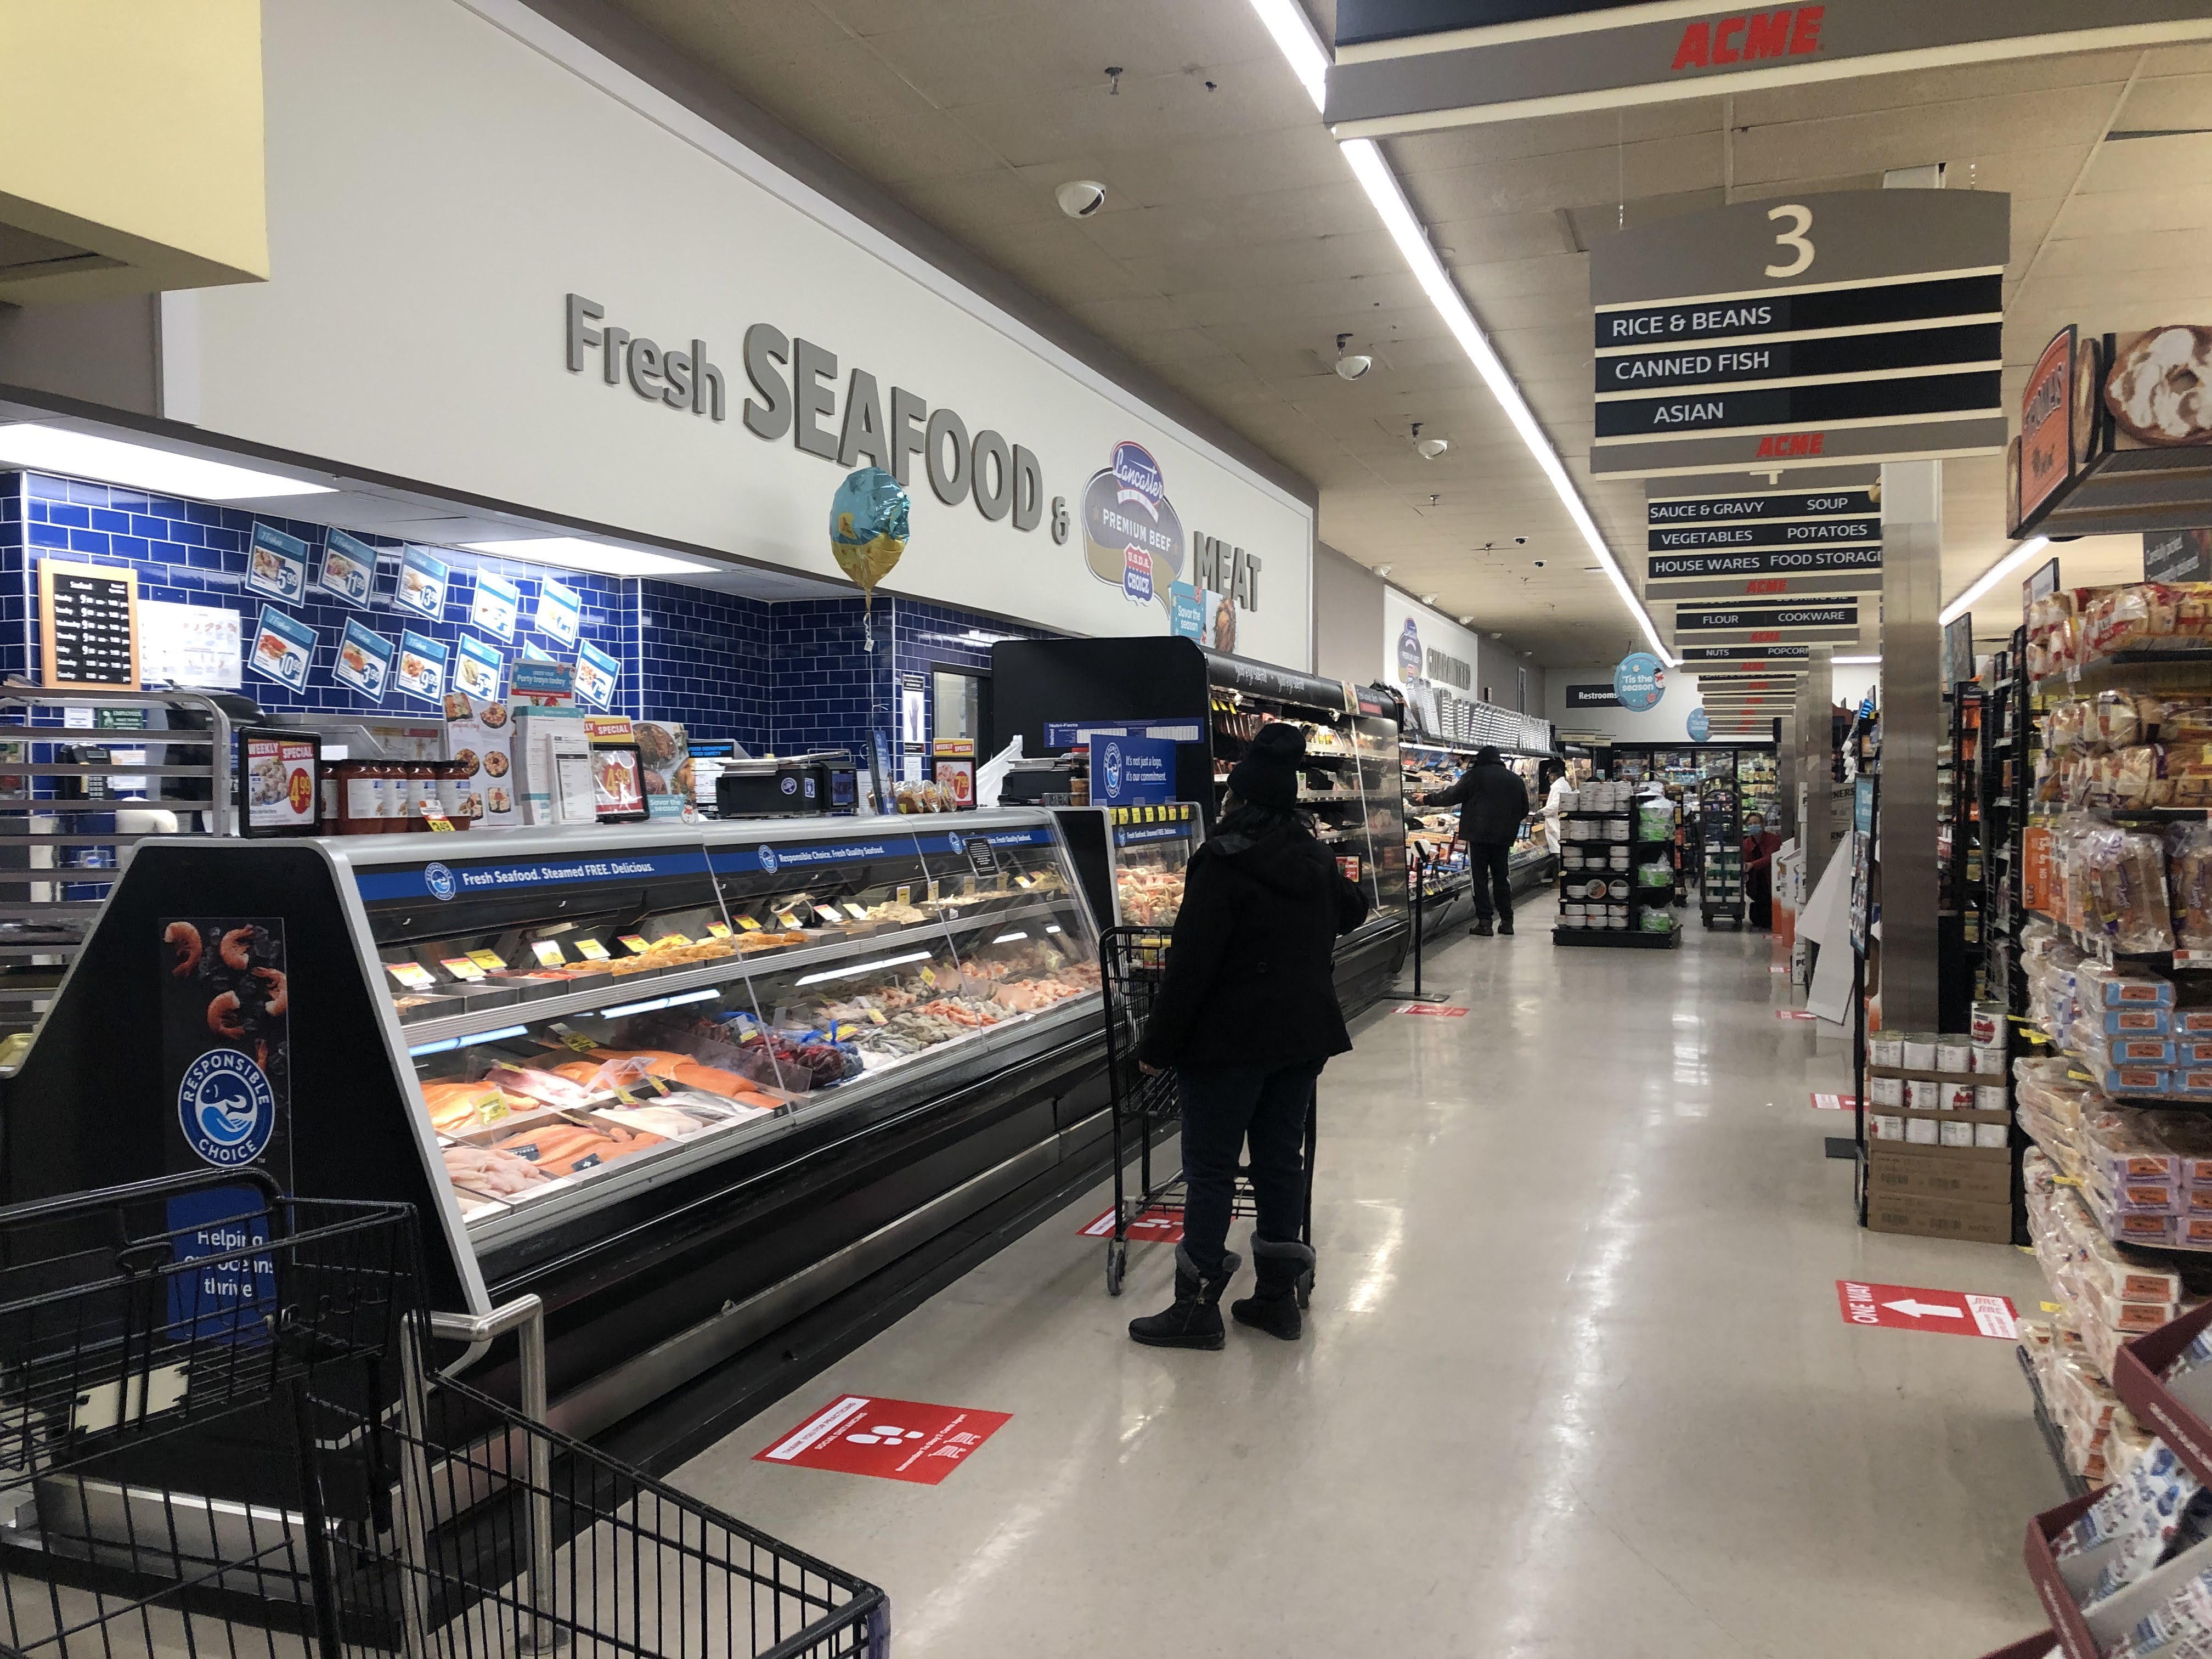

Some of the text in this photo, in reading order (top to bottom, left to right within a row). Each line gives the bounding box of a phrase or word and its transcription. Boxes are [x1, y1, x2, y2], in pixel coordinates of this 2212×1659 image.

[1671, 5, 1825, 70] ACME
[1764, 204, 1816, 278] 3
[1613, 306, 1771, 337] RICE & BEANS
[566, 293, 725, 421] Fresh
[1616, 351, 1770, 380] CANNED FISH
[1654, 403, 1723, 424] ASIAN
[743, 323, 1070, 545] SEAFOOD &
[1757, 433, 1825, 458] ACME
[1113, 448, 1163, 498] Lancaster
[1650, 498, 1848, 518] SAUCE & GRAVY SOUP
[1103, 509, 1171, 552] PREMIUM BEEF
[1662, 524, 1867, 545] VEGETABLES POTATOES
[1193, 531, 1262, 612] MEAT
[1656, 560, 1703, 572] HOUSE
[1707, 557, 1760, 570] WARES
[1770, 554, 1812, 566] FOOD
[1127, 573, 1150, 594] CHOICE
[1746, 579, 1788, 594] ACME
[1178, 605, 1201, 621] Savor the
[1703, 612, 1845, 624] FLOUR COOKWARE
[1180, 620, 1198, 632] season
[1622, 674, 1654, 684] 'Tis the
[1622, 684, 1654, 692] season
[1578, 692, 1617, 700] Restrooms
[598, 724, 628, 735] SPECIAL
[249, 742, 279, 755] WEEKLY
[283, 746, 314, 759] SPECIAL
[778, 852, 812, 864] Responsible
[832, 849, 846, 858] Fresh
[462, 861, 655, 885] Fresh Seafood. Steamed FREE. Delicious.
[183, 1054, 270, 1105] RESPONSIBLE
[199, 1139, 257, 1162] CHOICE
